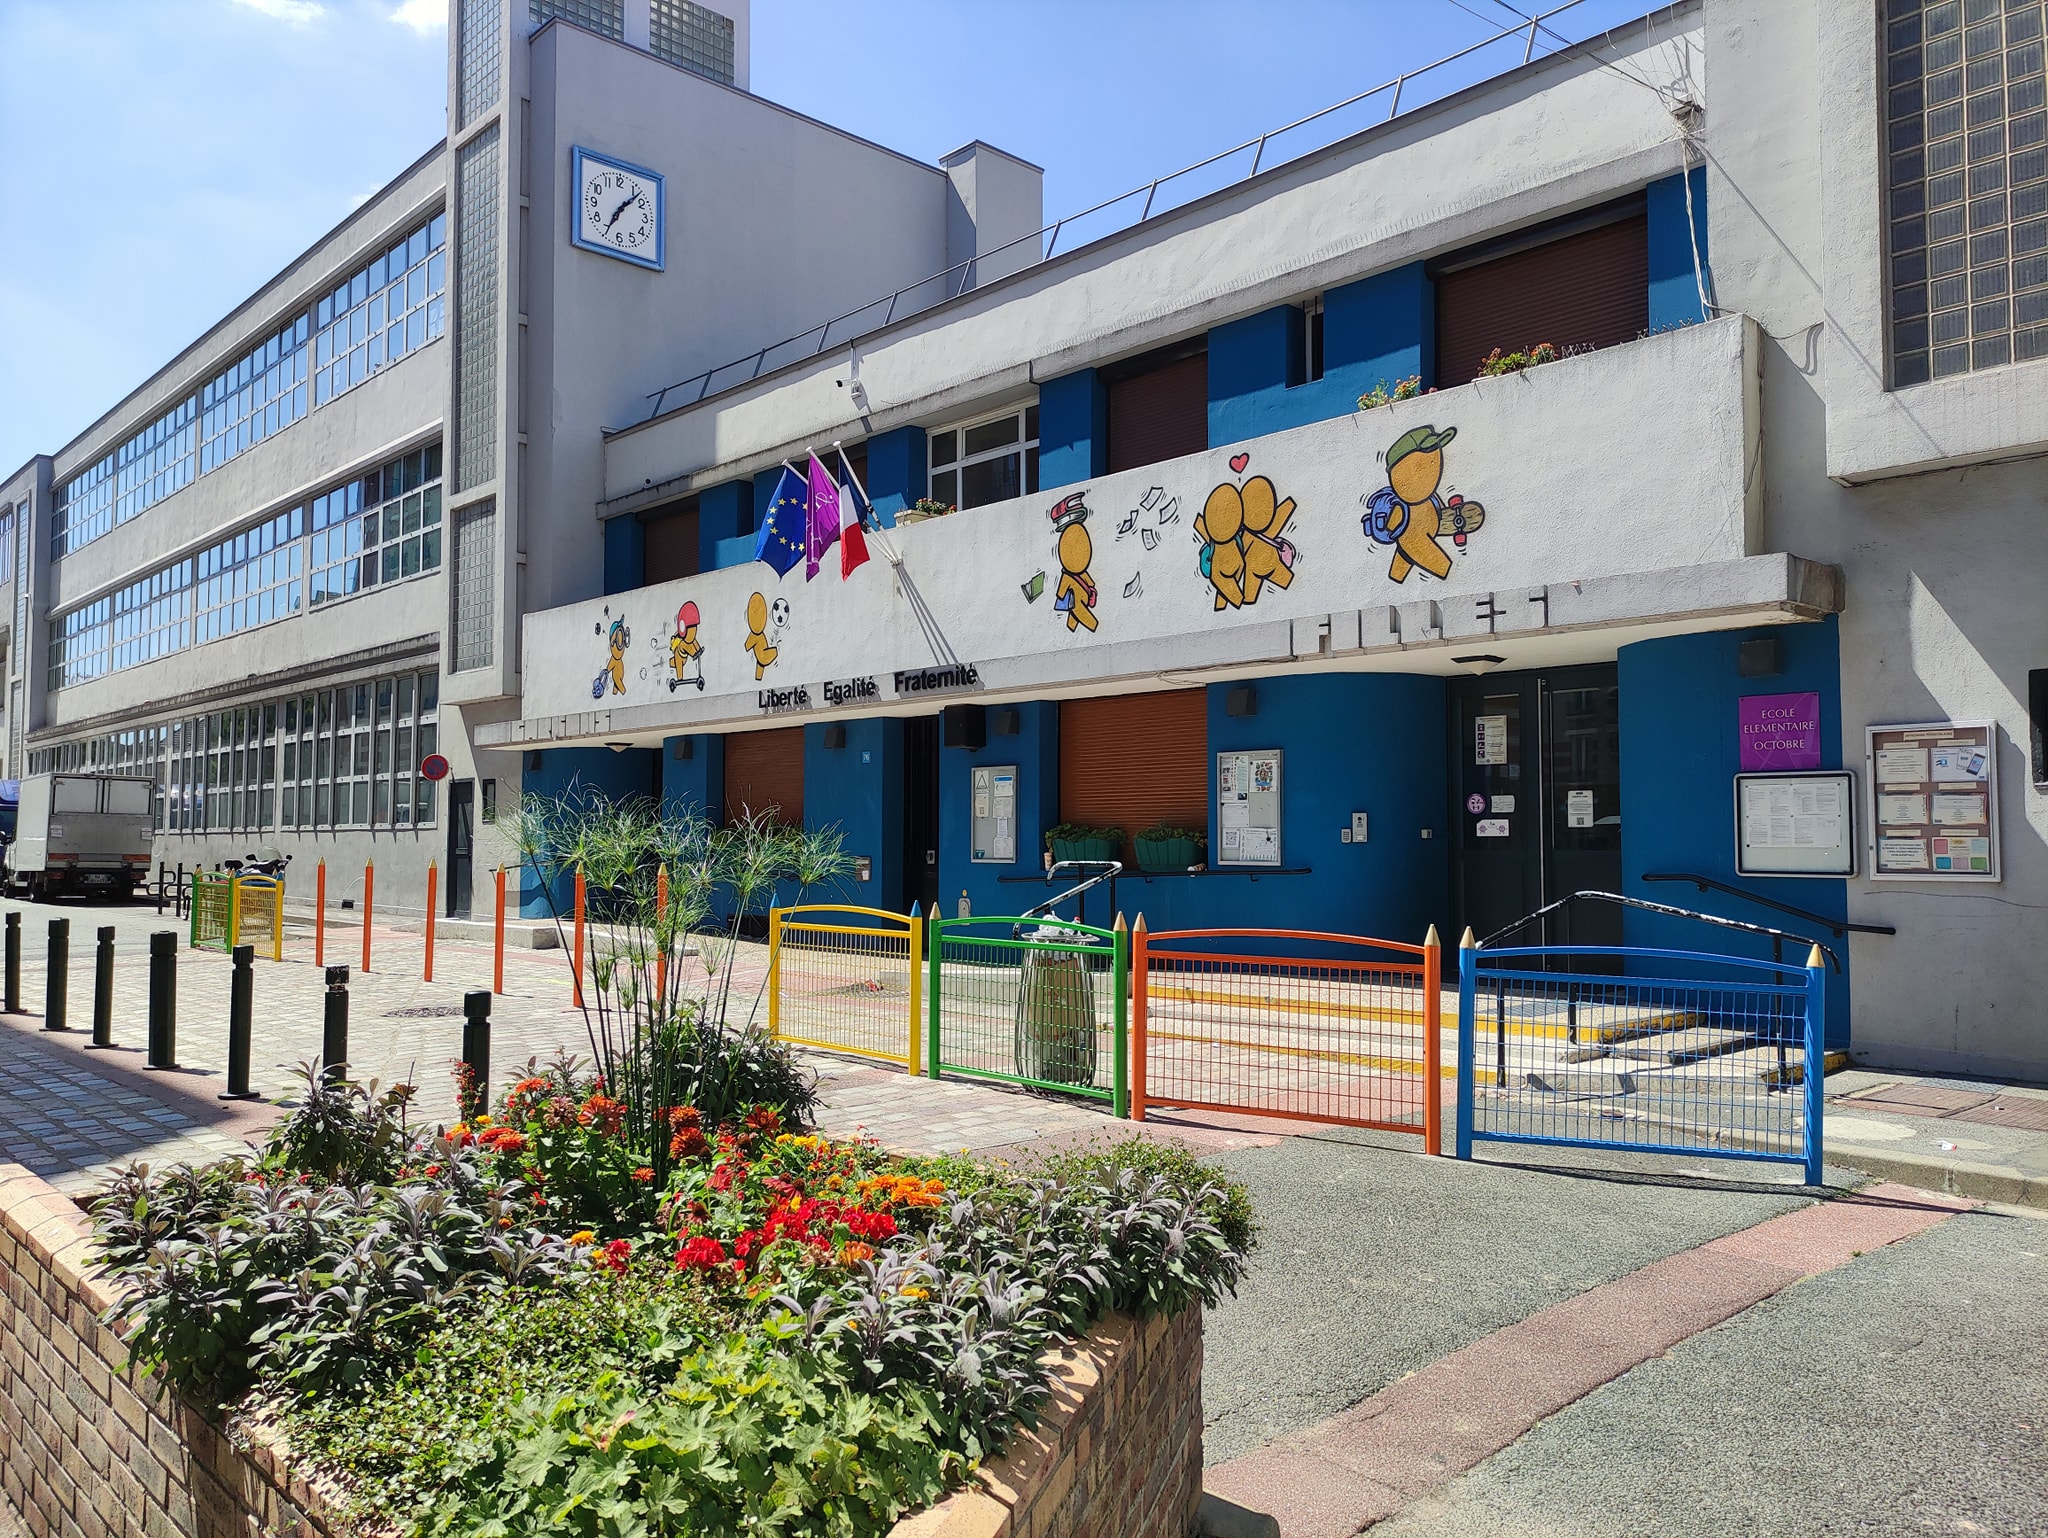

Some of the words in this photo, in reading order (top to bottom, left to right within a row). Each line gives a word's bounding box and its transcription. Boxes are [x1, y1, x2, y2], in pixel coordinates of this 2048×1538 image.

[604, 176, 611, 189] 11
[616, 176, 624, 189] 12
[593, 183, 602, 195] 10
[590, 196, 598, 208] 9
[638, 198, 645, 210] 2
[593, 211, 601, 223] 8
[641, 213, 649, 224] 3
[616, 232, 624, 243] 6
[628, 232, 636, 243] 5
[638, 226, 645, 237] 4
[758, 684, 808, 709] Liberté
[823, 676, 876, 705] Egalité
[894, 662, 978, 693] Fraternité
[1761, 708, 1796, 719] ECOLE
[1743, 720, 1815, 734] ELEMENTAIRE
[1754, 739, 1805, 751] OCTOBRE
